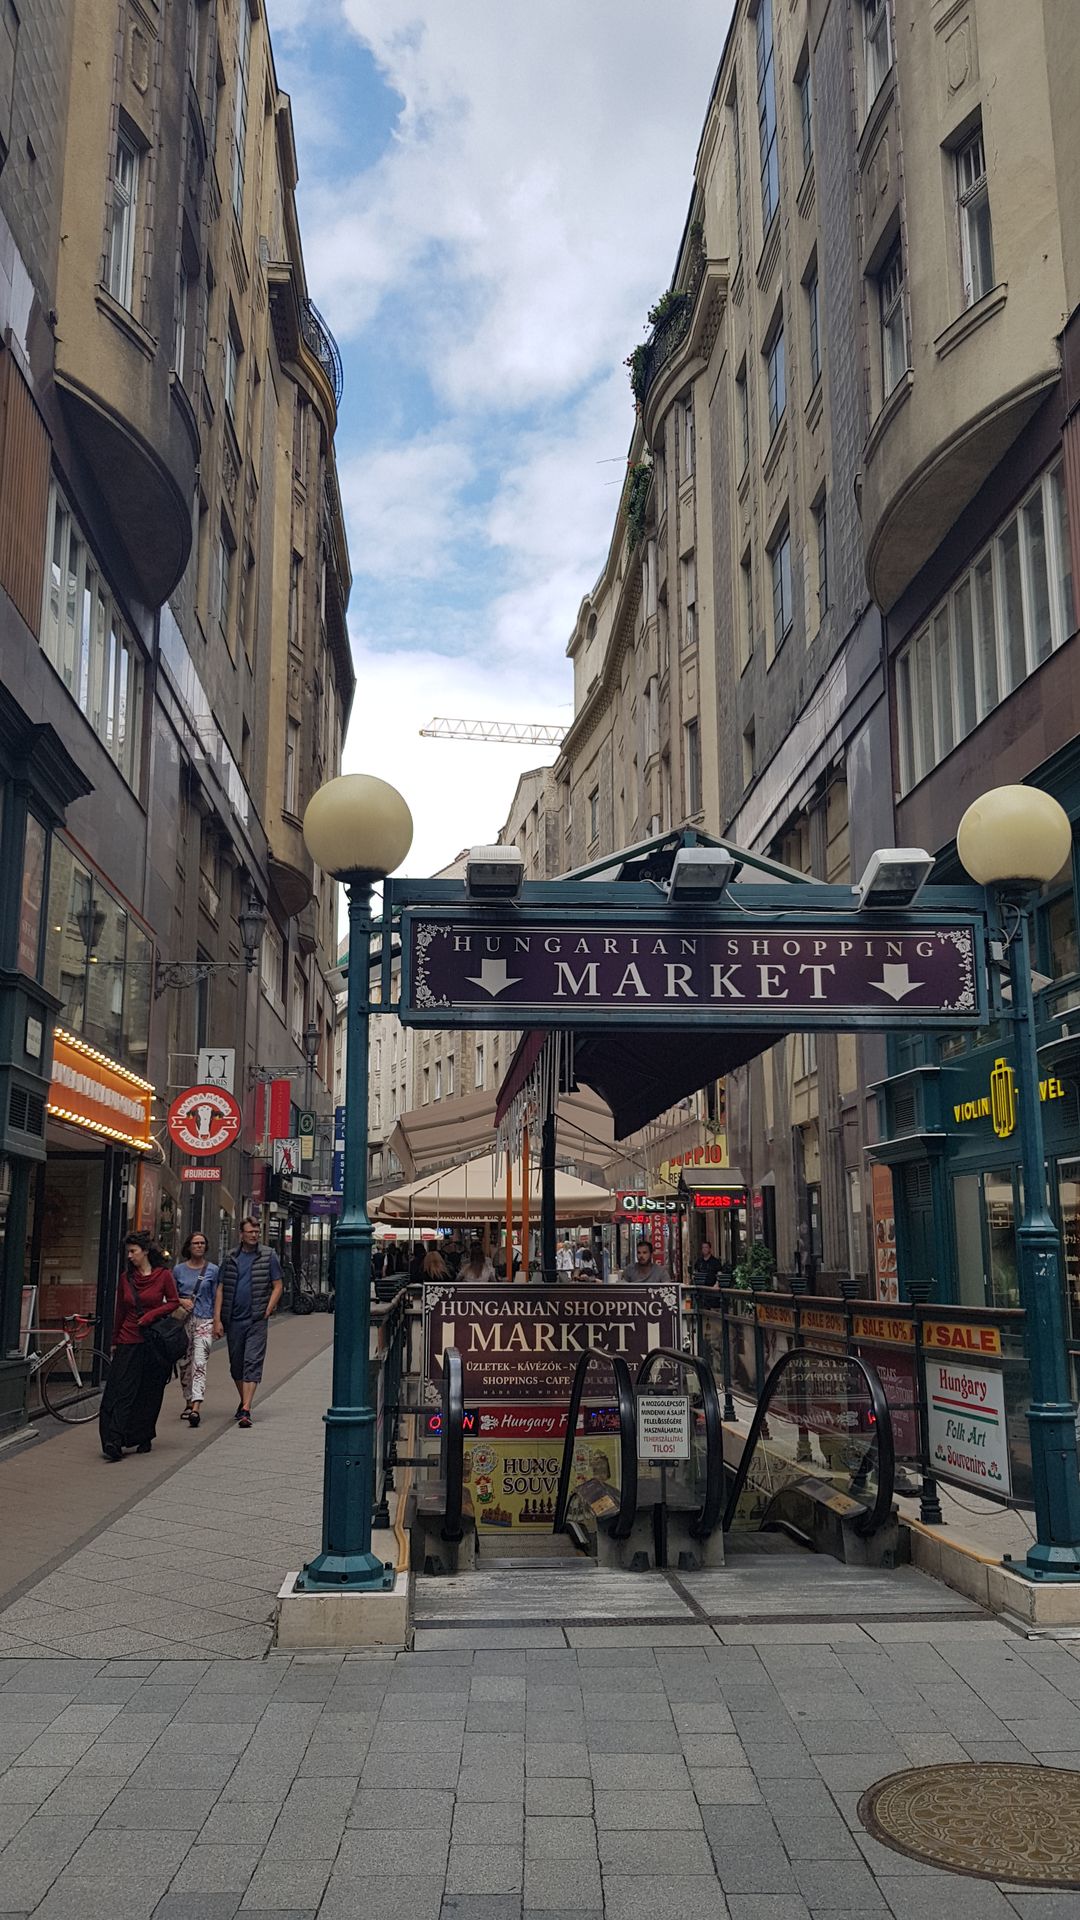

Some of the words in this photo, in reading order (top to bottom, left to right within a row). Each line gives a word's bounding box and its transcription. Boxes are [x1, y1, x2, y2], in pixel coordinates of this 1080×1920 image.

[453, 936, 698, 955] HUNGARIAN
[727, 939, 934, 957] SHOPPING
[553, 961, 836, 999] MARKET
[954, 1097, 989, 1123] VIOLIN
[184, 1169, 220, 1179] #BURGERS
[440, 1301, 560, 1317] HUNGARIAN
[564, 1301, 663, 1317] SHOPPING
[807, 1313, 824, 1328] SALE
[825, 1314, 842, 1331] 20%
[862, 1319, 884, 1337] SALE
[888, 1322, 908, 1340] 10%
[468, 1321, 636, 1352] MARKET
[936, 1325, 997, 1351] SALE
[483, 1376, 538, 1385] SHOPPINGS
[545, 1376, 570, 1385] CAFE
[939, 1368, 987, 1402] Hungary
[501, 1414, 555, 1433] Hungary
[946, 1419, 965, 1442] Folk
[968, 1427, 987, 1448] Art
[652, 1444, 676, 1453] TILOS!
[503, 1458, 559, 1474] HUNG
[946, 1444, 987, 1477] Souvenirs
[503, 1477, 561, 1494] SOUV
